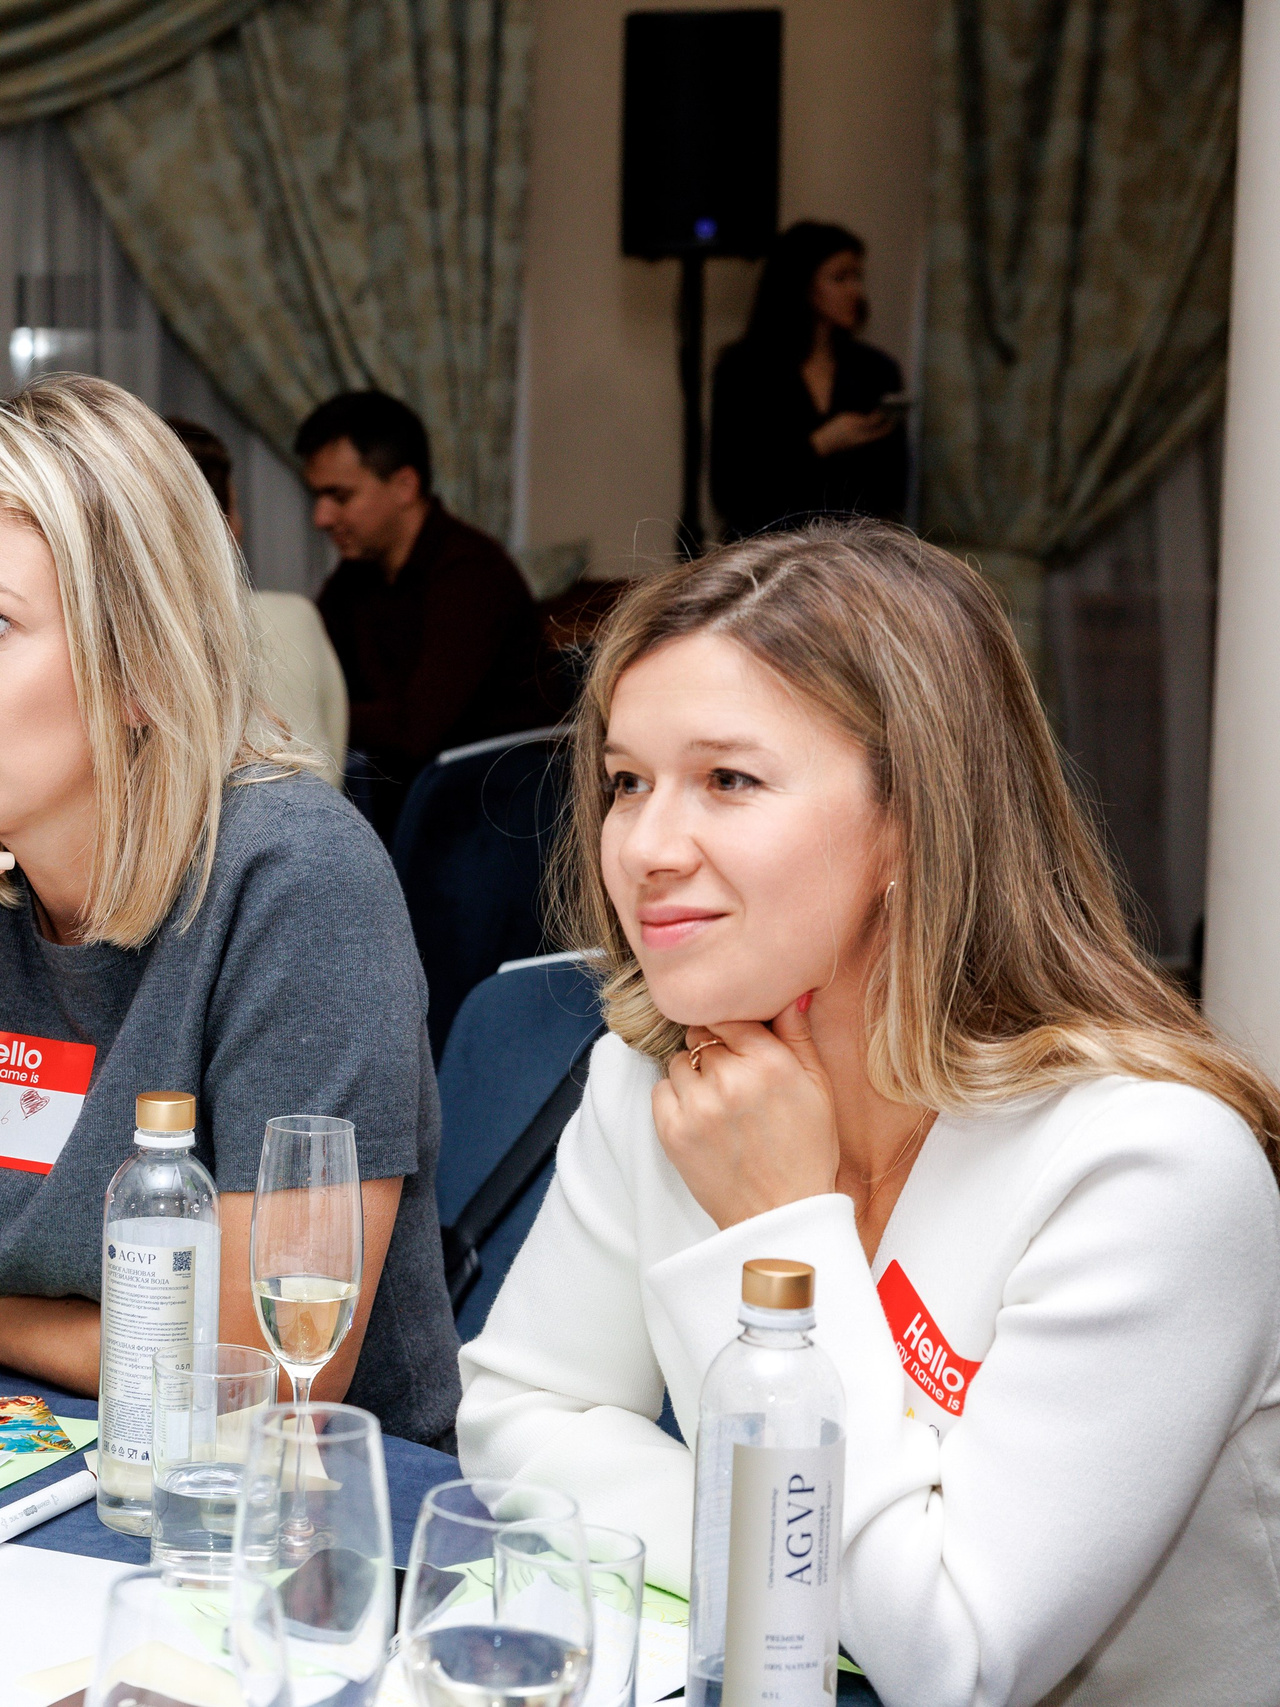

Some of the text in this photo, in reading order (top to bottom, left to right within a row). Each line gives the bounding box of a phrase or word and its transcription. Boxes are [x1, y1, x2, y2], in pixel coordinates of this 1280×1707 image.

[29, 1071, 39, 1083] is
[118, 1249, 157, 1265] AGVP
[135, 1345, 166, 1353] ФОРМУ
[903, 1311, 965, 1393] Hello
[895, 1340, 960, 1411] my name is
[785, 1473, 816, 1586] AGVP
[765, 1634, 805, 1642] PREMIUM
